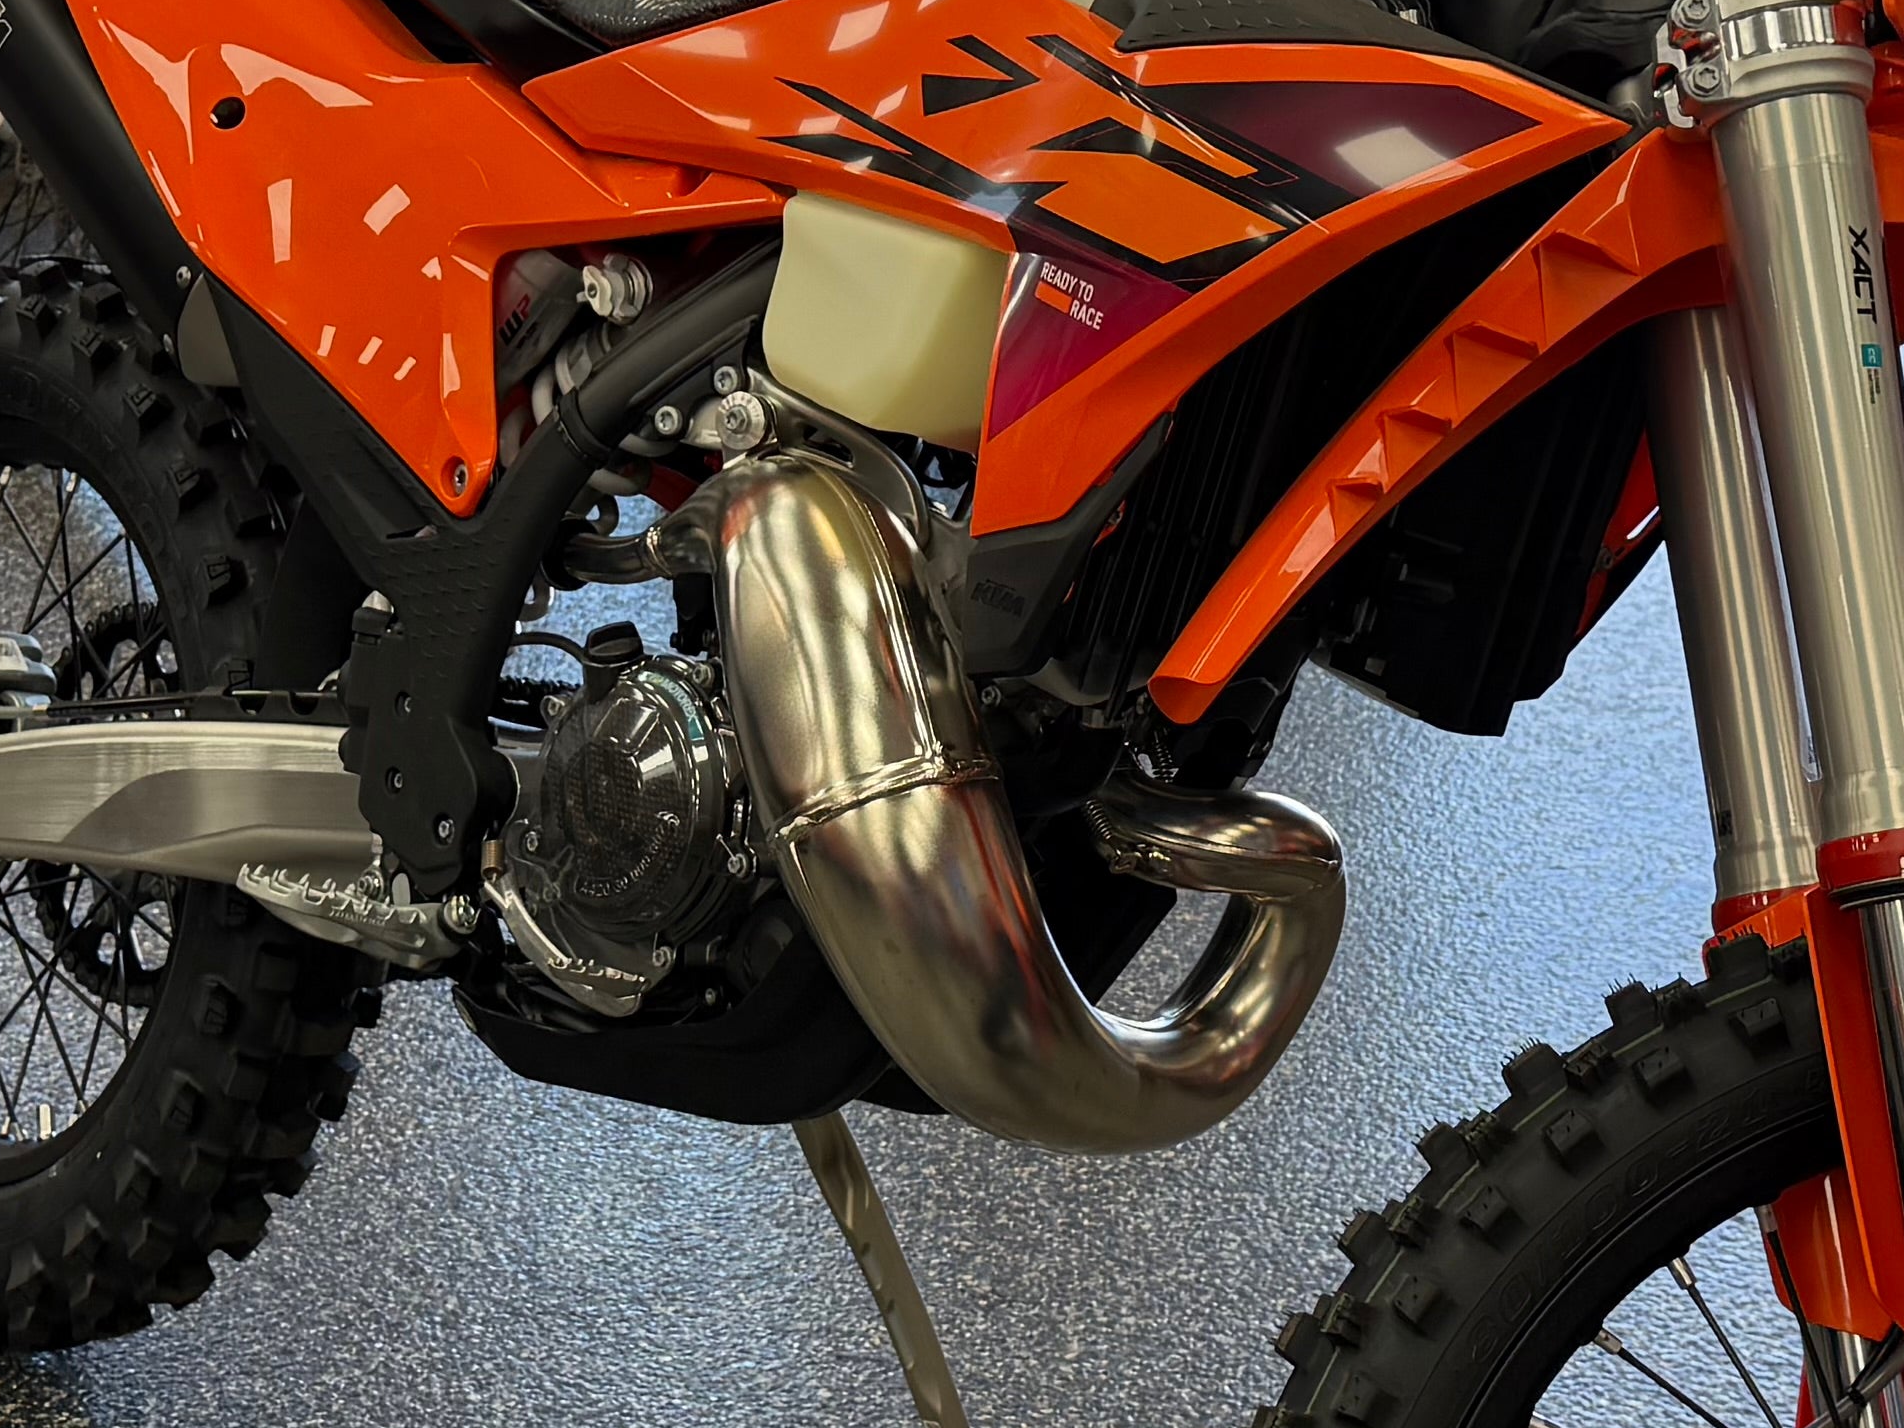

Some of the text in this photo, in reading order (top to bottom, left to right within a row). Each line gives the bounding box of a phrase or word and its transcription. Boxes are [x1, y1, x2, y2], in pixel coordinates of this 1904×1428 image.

[1040, 261, 1095, 303] READY TO
[1848, 225, 1878, 325] XACT
[1069, 299, 1104, 332] RACE
